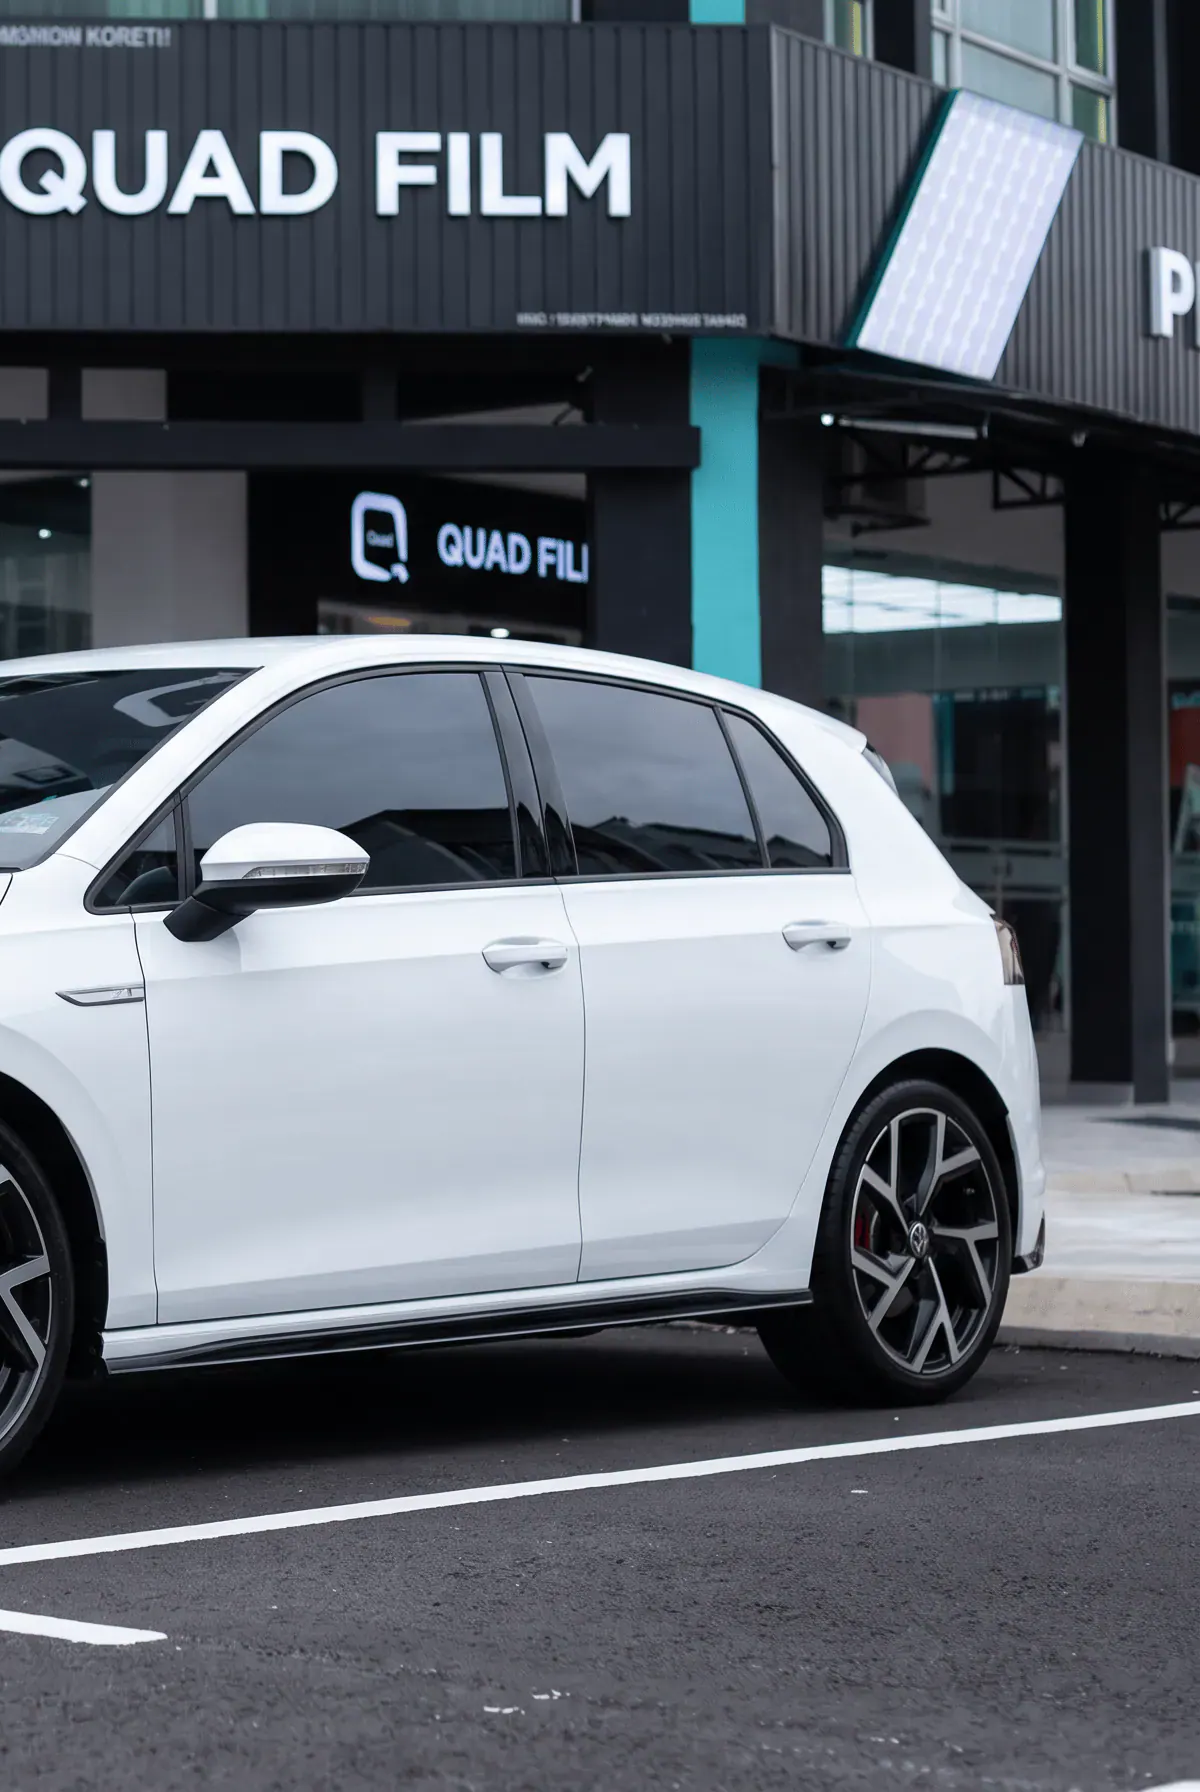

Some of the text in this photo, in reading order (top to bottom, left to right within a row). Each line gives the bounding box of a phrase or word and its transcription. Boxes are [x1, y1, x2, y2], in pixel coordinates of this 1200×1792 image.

[375, 131, 632, 217] FILM
[1151, 246, 1200, 349] P
[437, 522, 532, 575] QUAD
